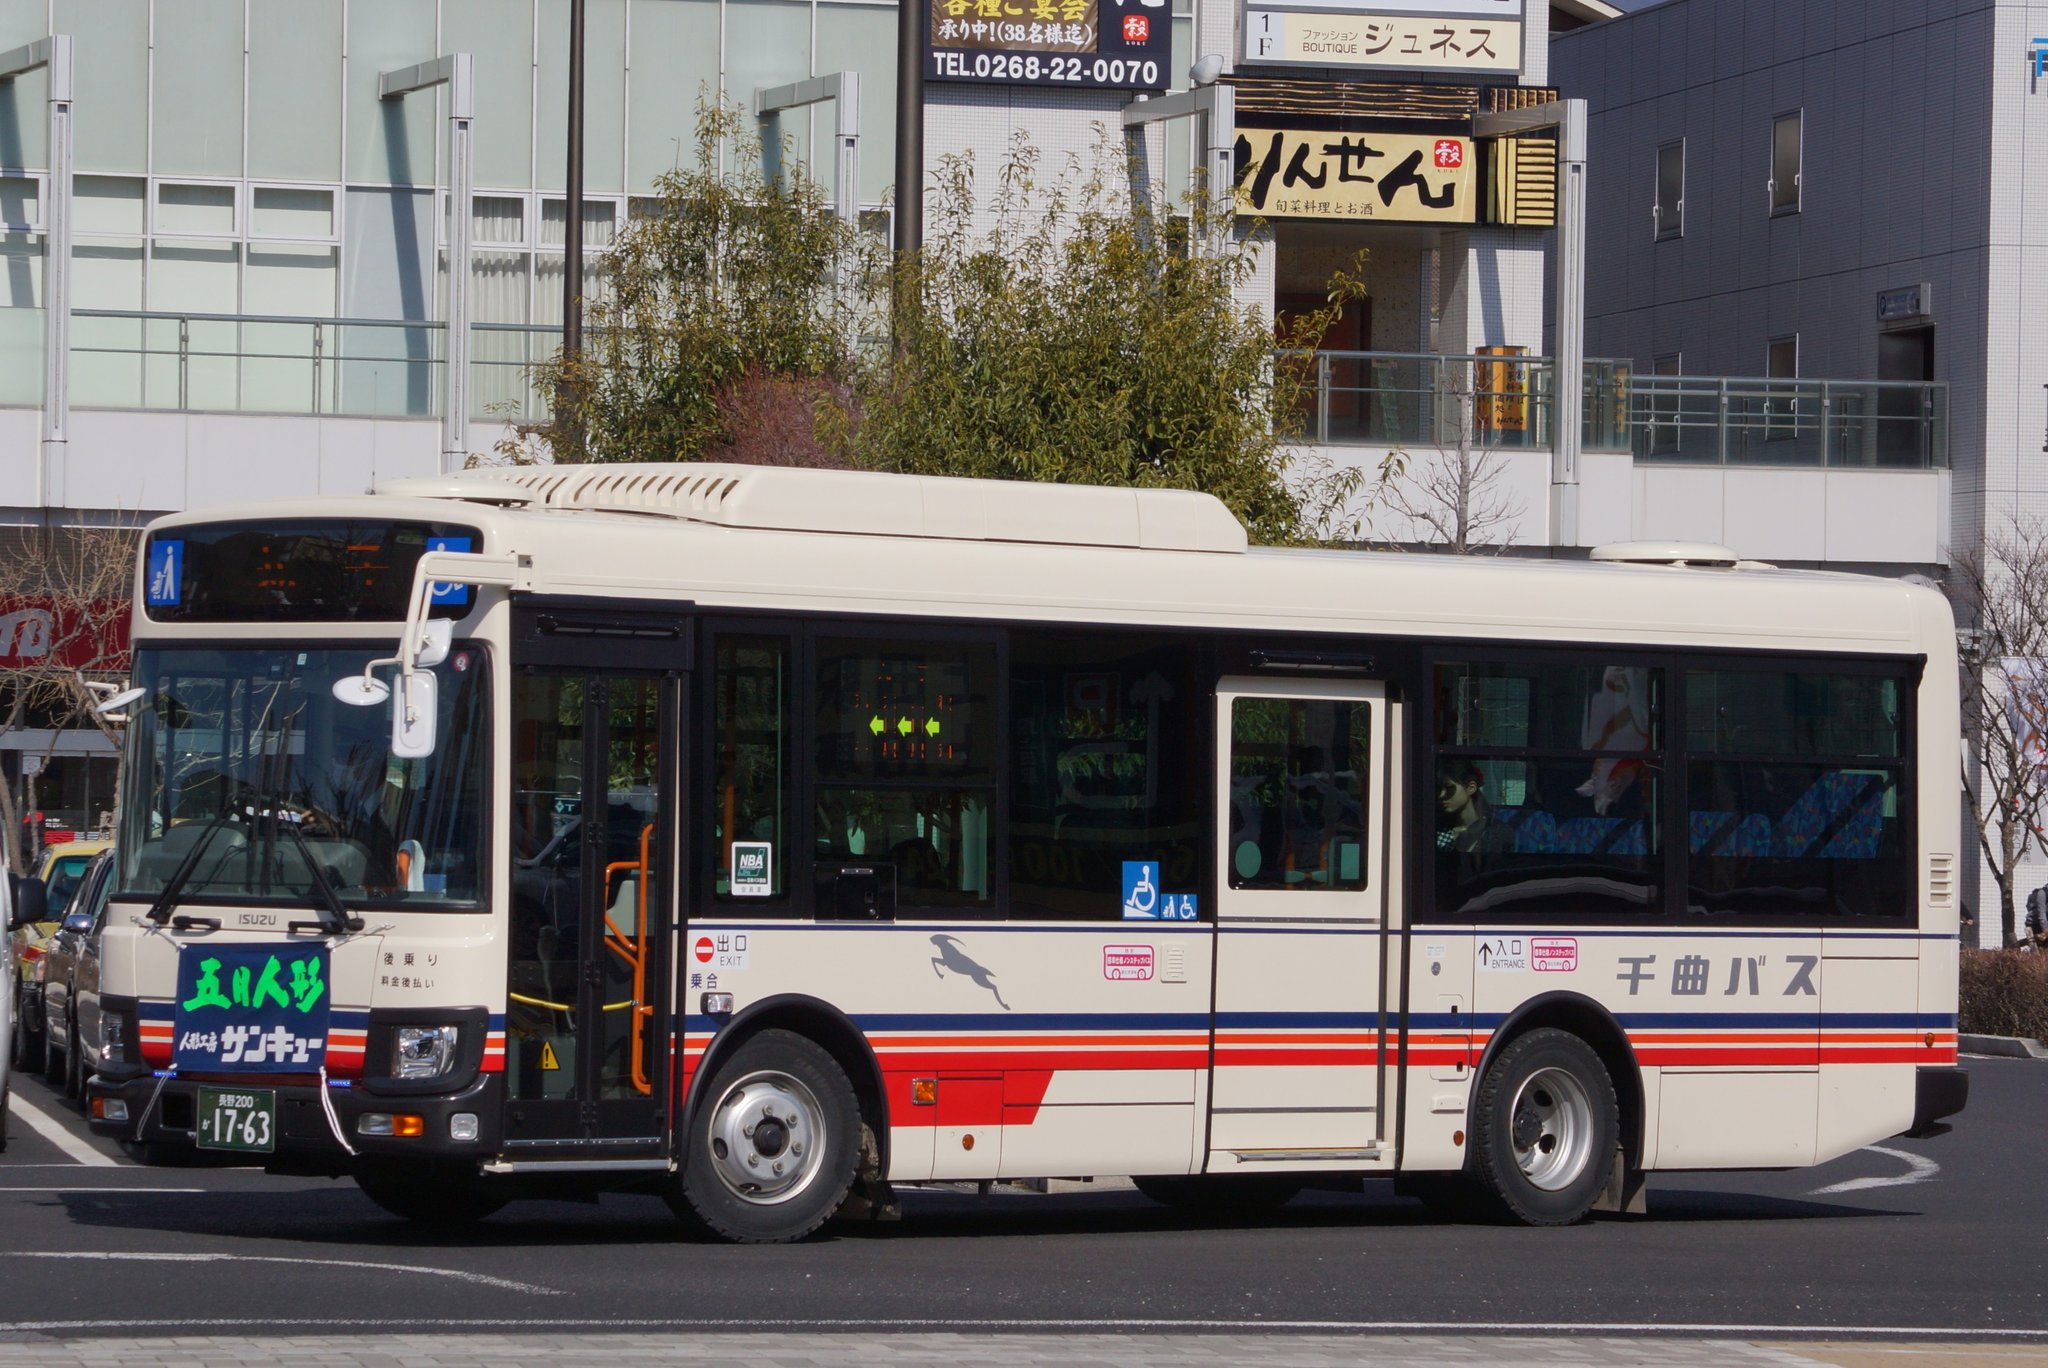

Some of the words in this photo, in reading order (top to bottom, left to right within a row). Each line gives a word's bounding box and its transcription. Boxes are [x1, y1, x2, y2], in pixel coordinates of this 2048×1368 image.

[1302, 29, 1359, 41] ファッション
[1365, 23, 1497, 60] ジュネス
[1302, 42, 1357, 54] BOUTIQUE
[933, 51, 1158, 85] TEL.0268-22-0070
[1275, 199, 1373, 215] 旬菜料理とお酒
[740, 854, 764, 867] NBA
[238, 913, 277, 926] ISUZU
[717, 934, 747, 952] 出口
[1496, 939, 1521, 955] 入口
[384, 952, 439, 966] 後乗り
[720, 955, 743, 967] EXIT
[1492, 959, 1526, 969] ENTRANCE
[381, 975, 435, 988] 料金後払い
[691, 973, 718, 989] 乗合
[1616, 954, 1818, 996] 千曲バス
[182, 954, 325, 1013] 五月人形
[220, 1025, 323, 1062] サンキュー
[214, 1108, 271, 1145] 17-63
